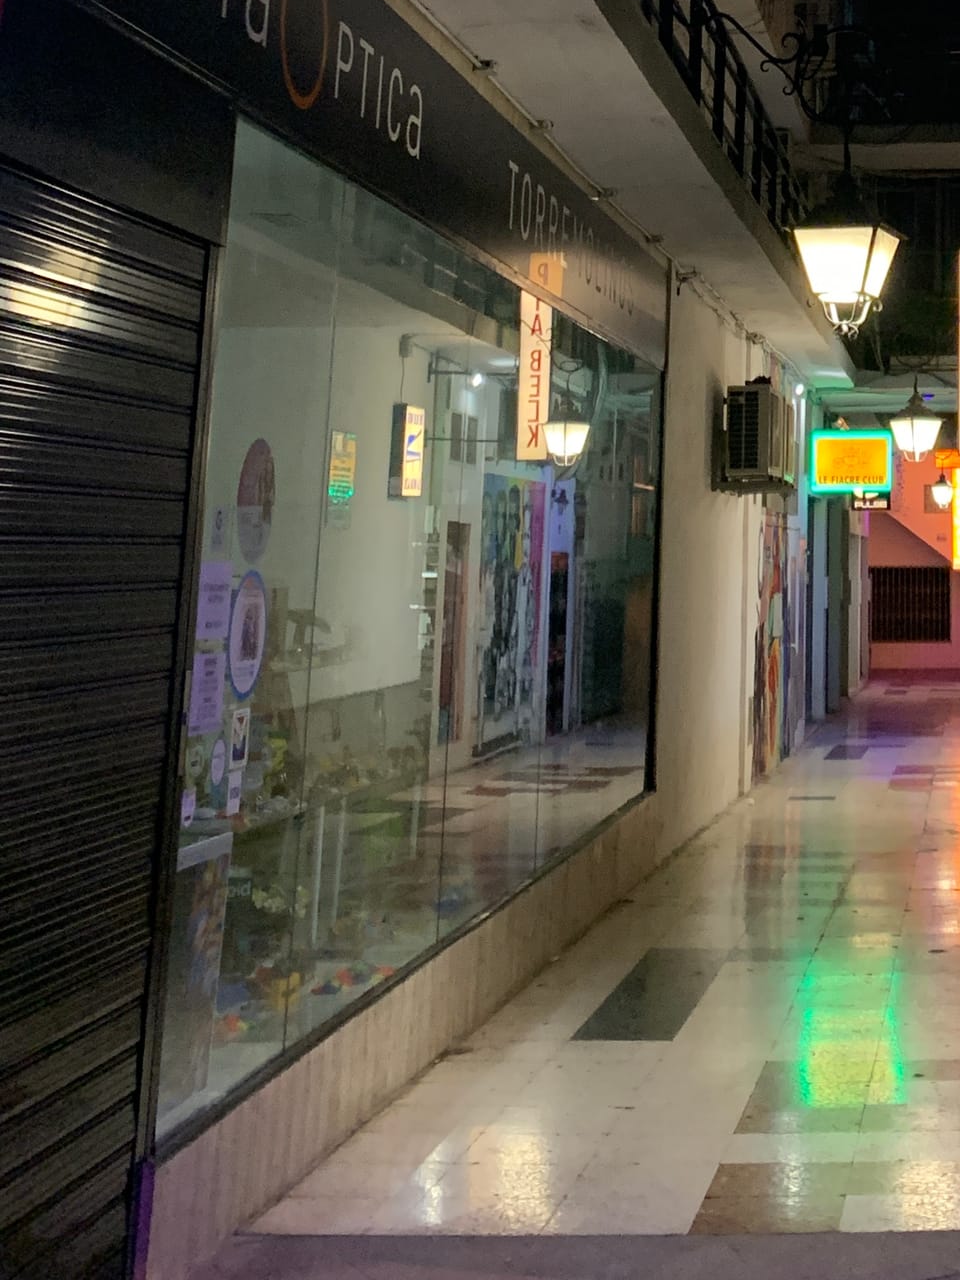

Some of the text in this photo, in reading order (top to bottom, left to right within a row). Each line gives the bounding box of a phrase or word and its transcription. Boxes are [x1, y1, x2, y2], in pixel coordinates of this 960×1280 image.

[818, 475, 884, 485] LE FIACRE CLUB
